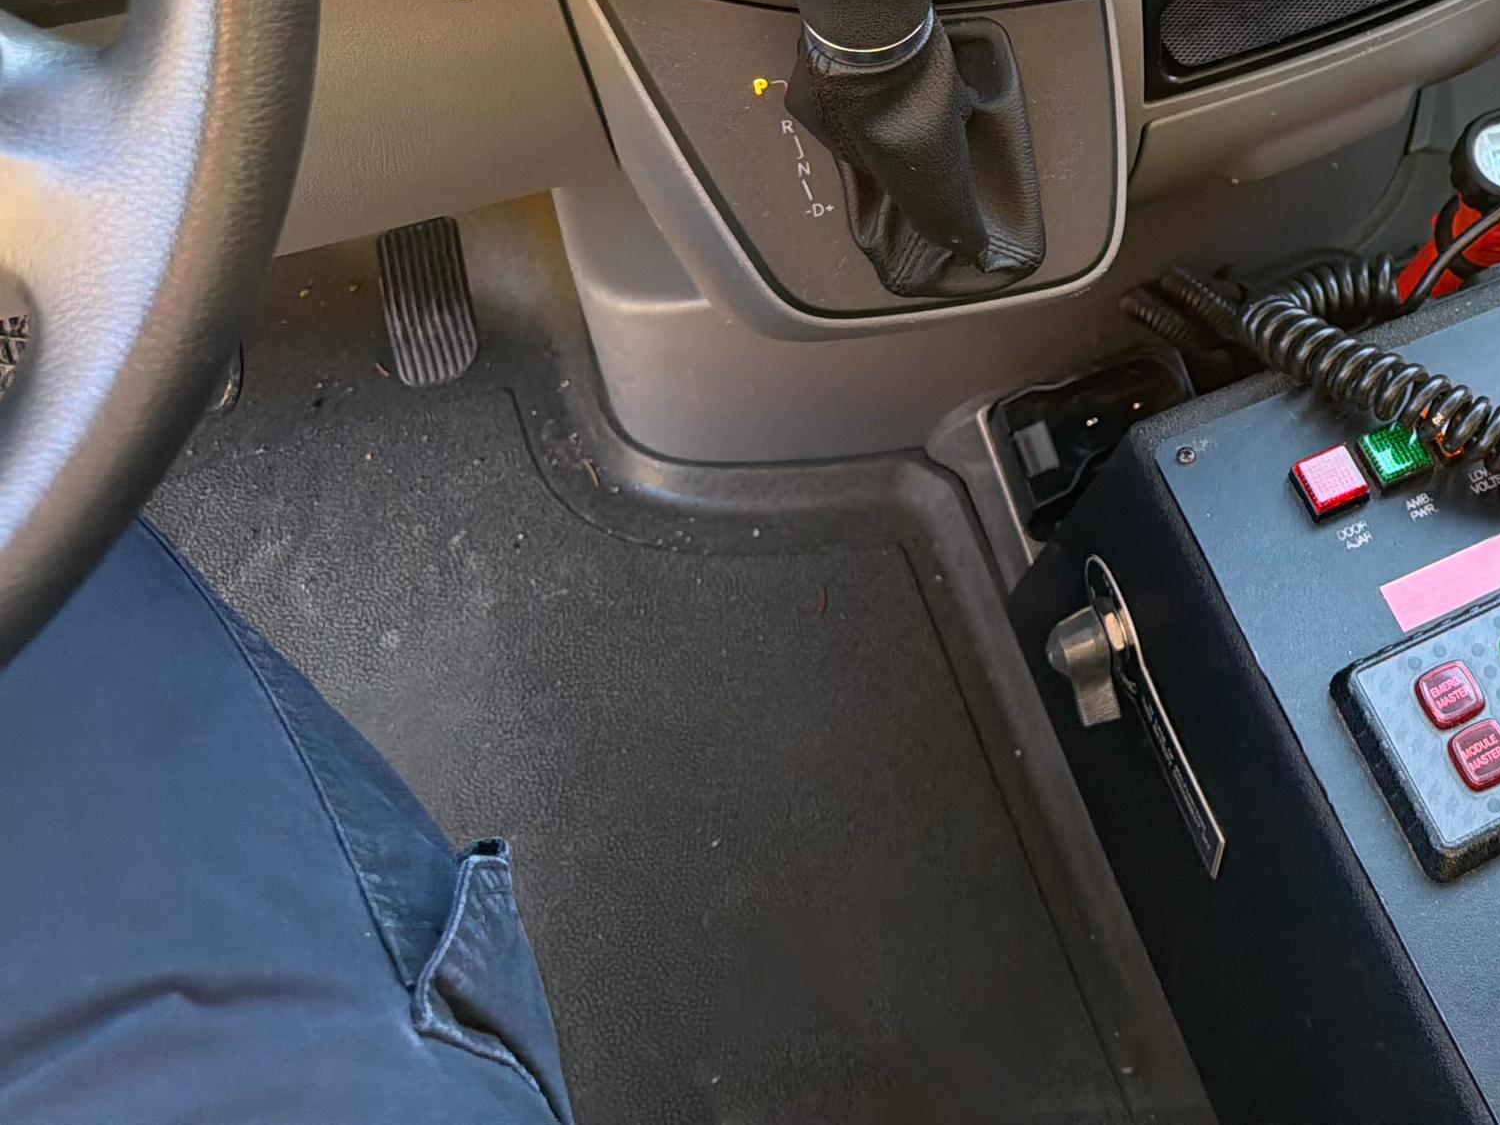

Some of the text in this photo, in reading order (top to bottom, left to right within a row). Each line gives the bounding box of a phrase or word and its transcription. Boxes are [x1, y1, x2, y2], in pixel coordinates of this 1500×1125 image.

[752, 78, 769, 96] P
[781, 120, 795, 134] R
[797, 161, 812, 177] N
[1405, 492, 1434, 511] AMB.
[1409, 505, 1439, 522] PWR.
[1336, 520, 1367, 541] DOOR
[1346, 531, 1374, 550] AJAR
[1436, 685, 1470, 709] MASTER
[1461, 733, 1499, 760] MODULE
